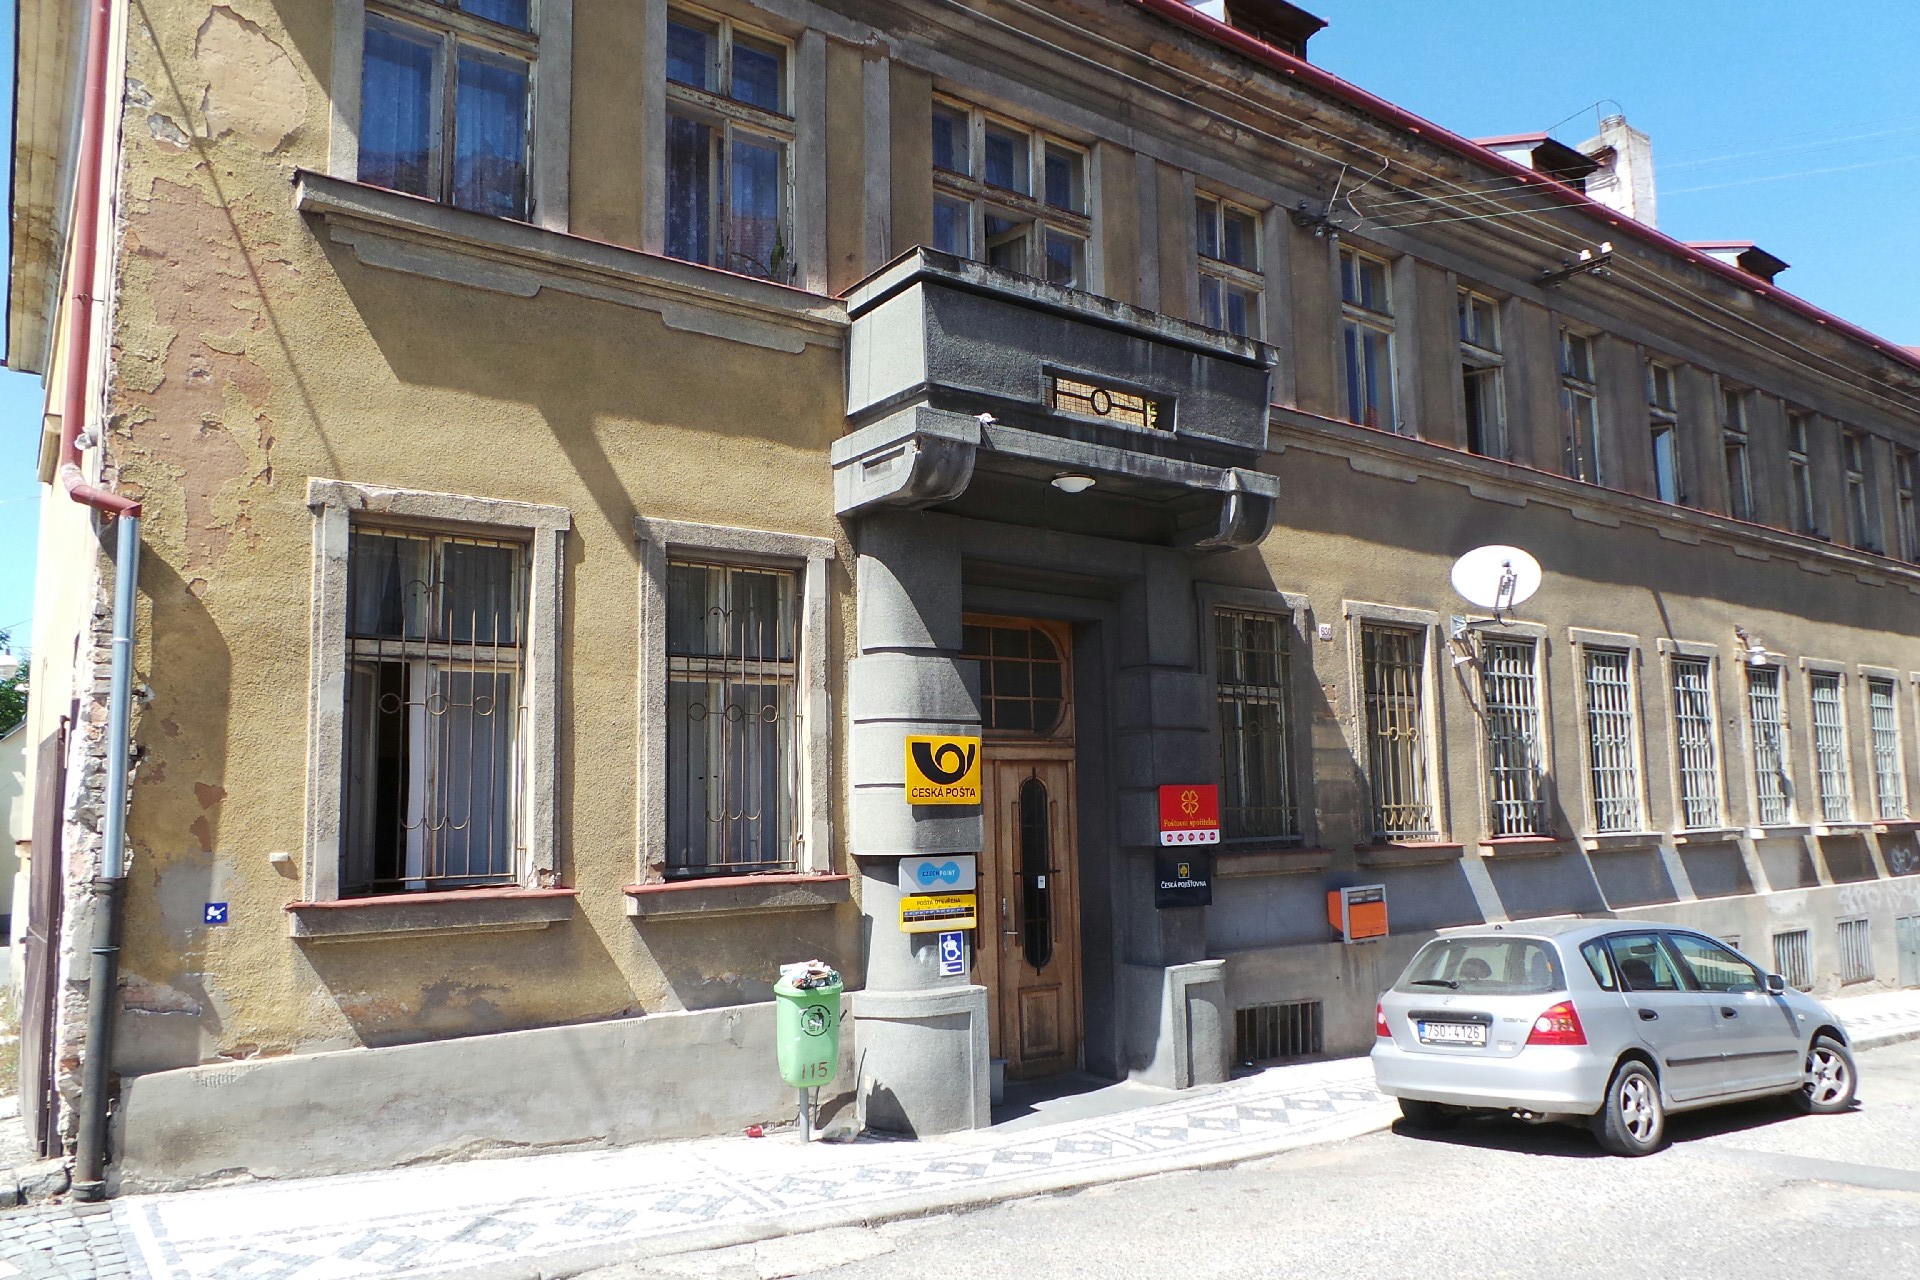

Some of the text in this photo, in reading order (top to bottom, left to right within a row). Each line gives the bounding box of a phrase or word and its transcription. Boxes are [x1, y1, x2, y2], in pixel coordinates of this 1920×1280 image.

[911, 786, 976, 798] ČESKÁ POŠTA
[1161, 880, 1206, 889] ČESKÁ POJIŠŤOVNA
[803, 1062, 827, 1079] 115
